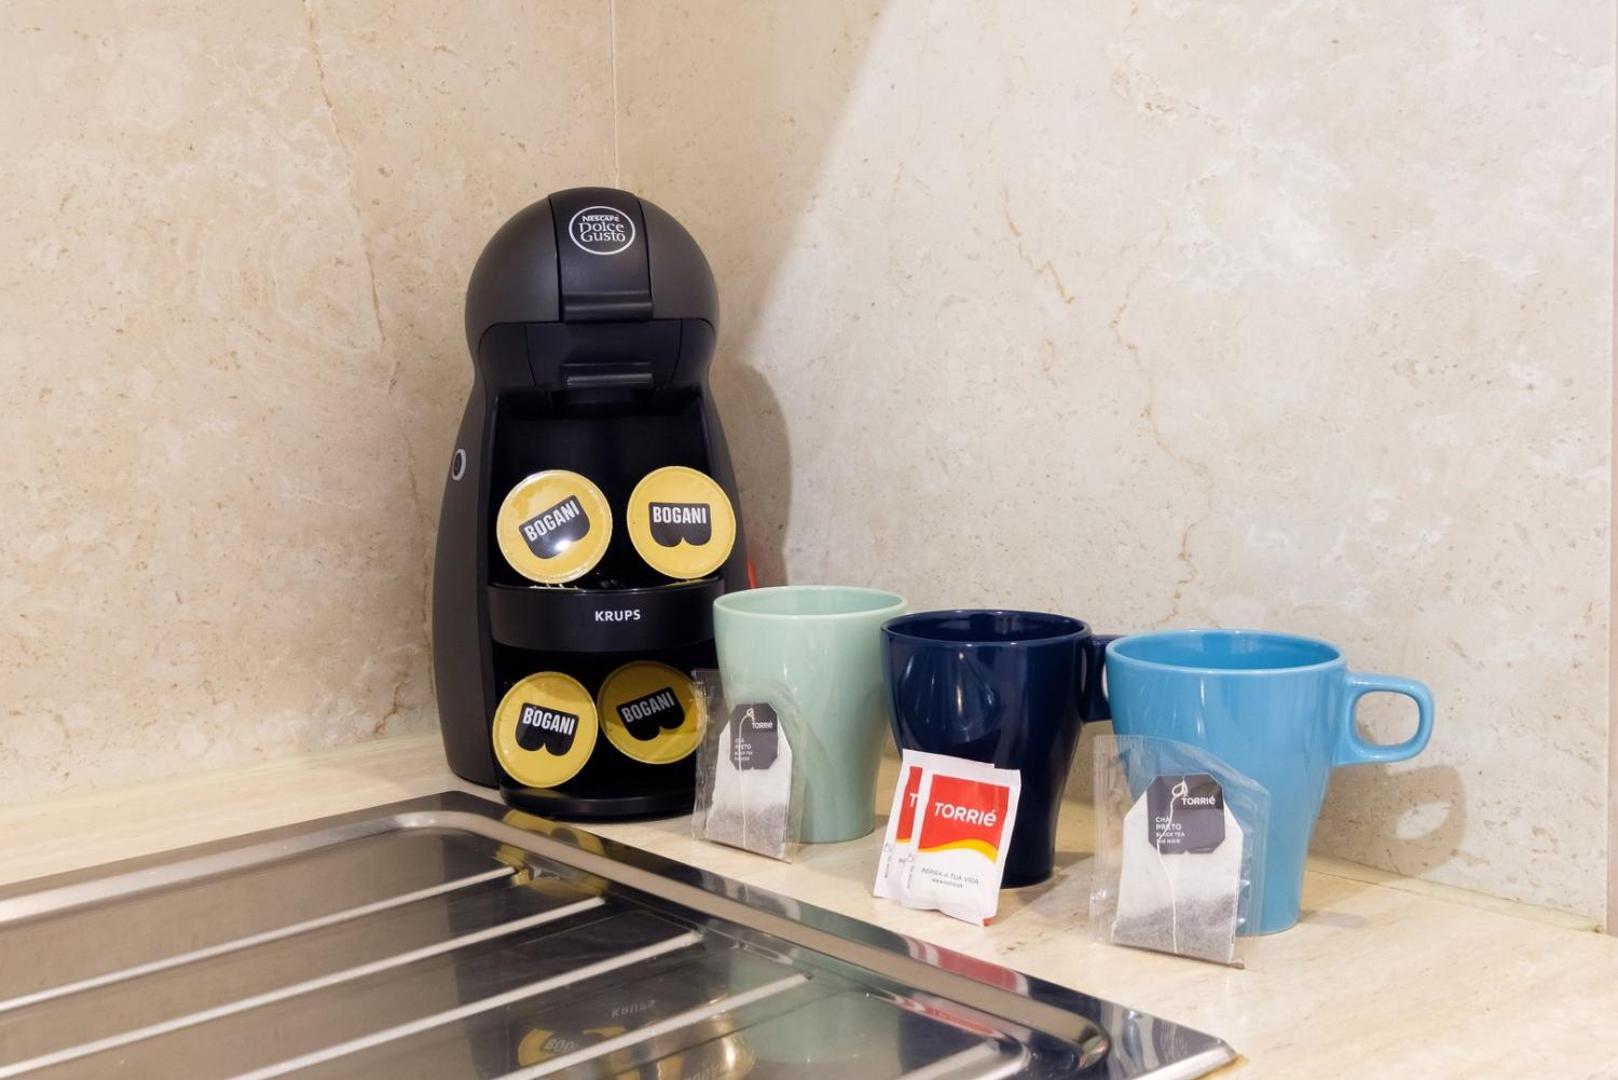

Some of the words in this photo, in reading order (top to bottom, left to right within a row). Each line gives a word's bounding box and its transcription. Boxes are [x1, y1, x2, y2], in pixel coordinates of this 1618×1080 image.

[578, 222, 624, 233] Dolce
[580, 231, 626, 242] Gusto
[524, 500, 580, 542] BOGANI
[652, 505, 707, 524] BOGANI
[594, 609, 642, 622] KRUPS
[620, 691, 676, 724] BOGANI
[522, 706, 576, 736] BOGANI
